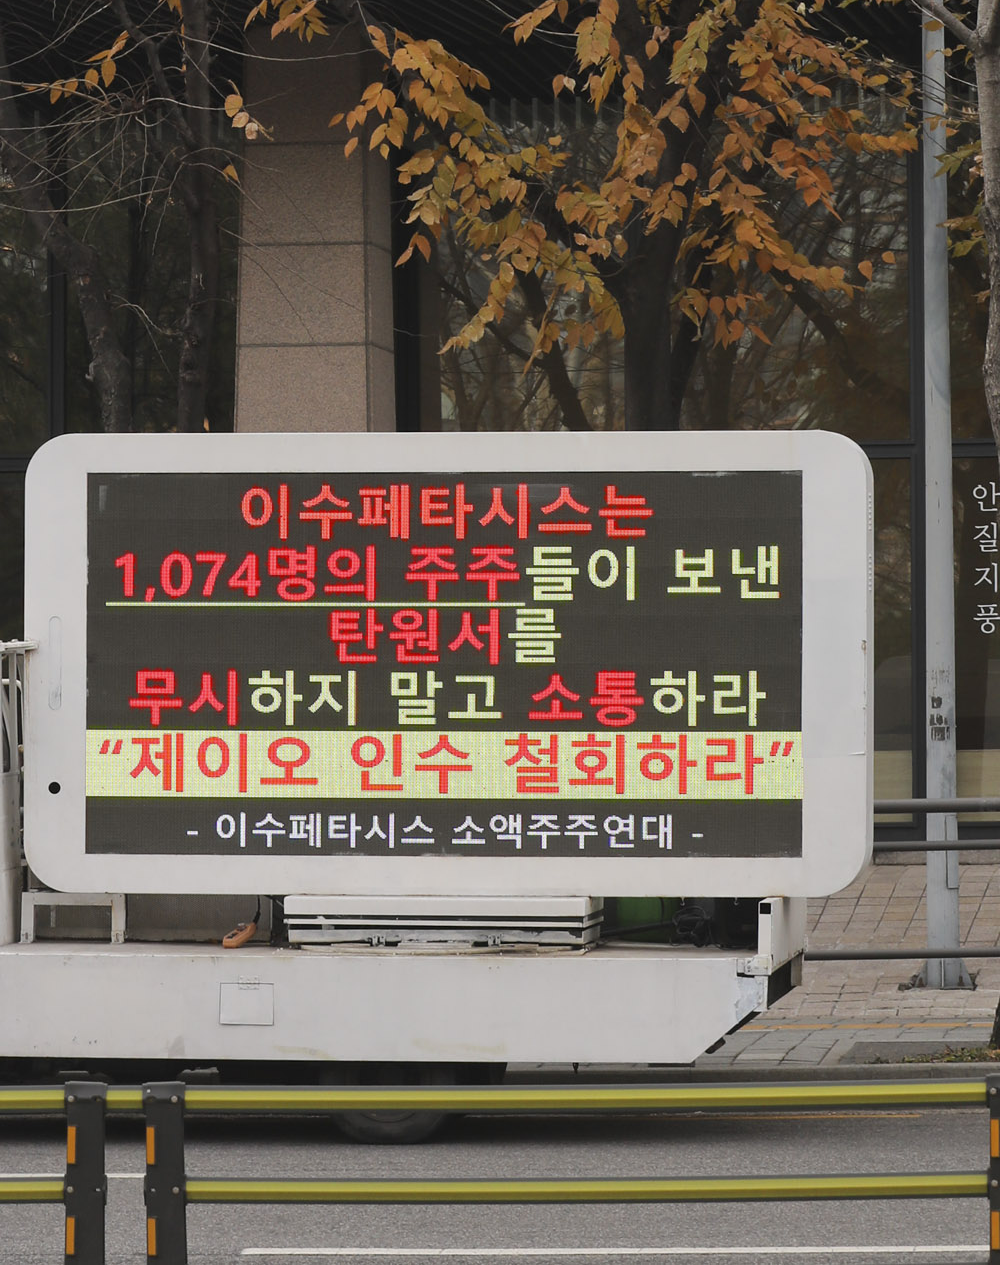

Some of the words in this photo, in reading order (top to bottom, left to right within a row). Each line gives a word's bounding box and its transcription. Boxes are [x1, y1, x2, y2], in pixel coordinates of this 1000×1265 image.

[241, 484, 655, 542] 이수페타시스는
[114, 546, 378, 602] 1,074명의
[405, 546, 637, 602] 주주들이
[667, 546, 781, 600] 보낸
[329, 608, 562, 666] 탄원서를
[129, 670, 358, 727] 무시하지
[390, 671, 504, 726] 말고
[528, 671, 768, 728] 소통하라
[98, 734, 320, 793] “제이오
[350, 734, 474, 795] 인수
[504, 734, 796, 795] 철회하라”
[216, 813, 436, 850] 이수페타시스
[452, 813, 674, 850] 소액주주연대
